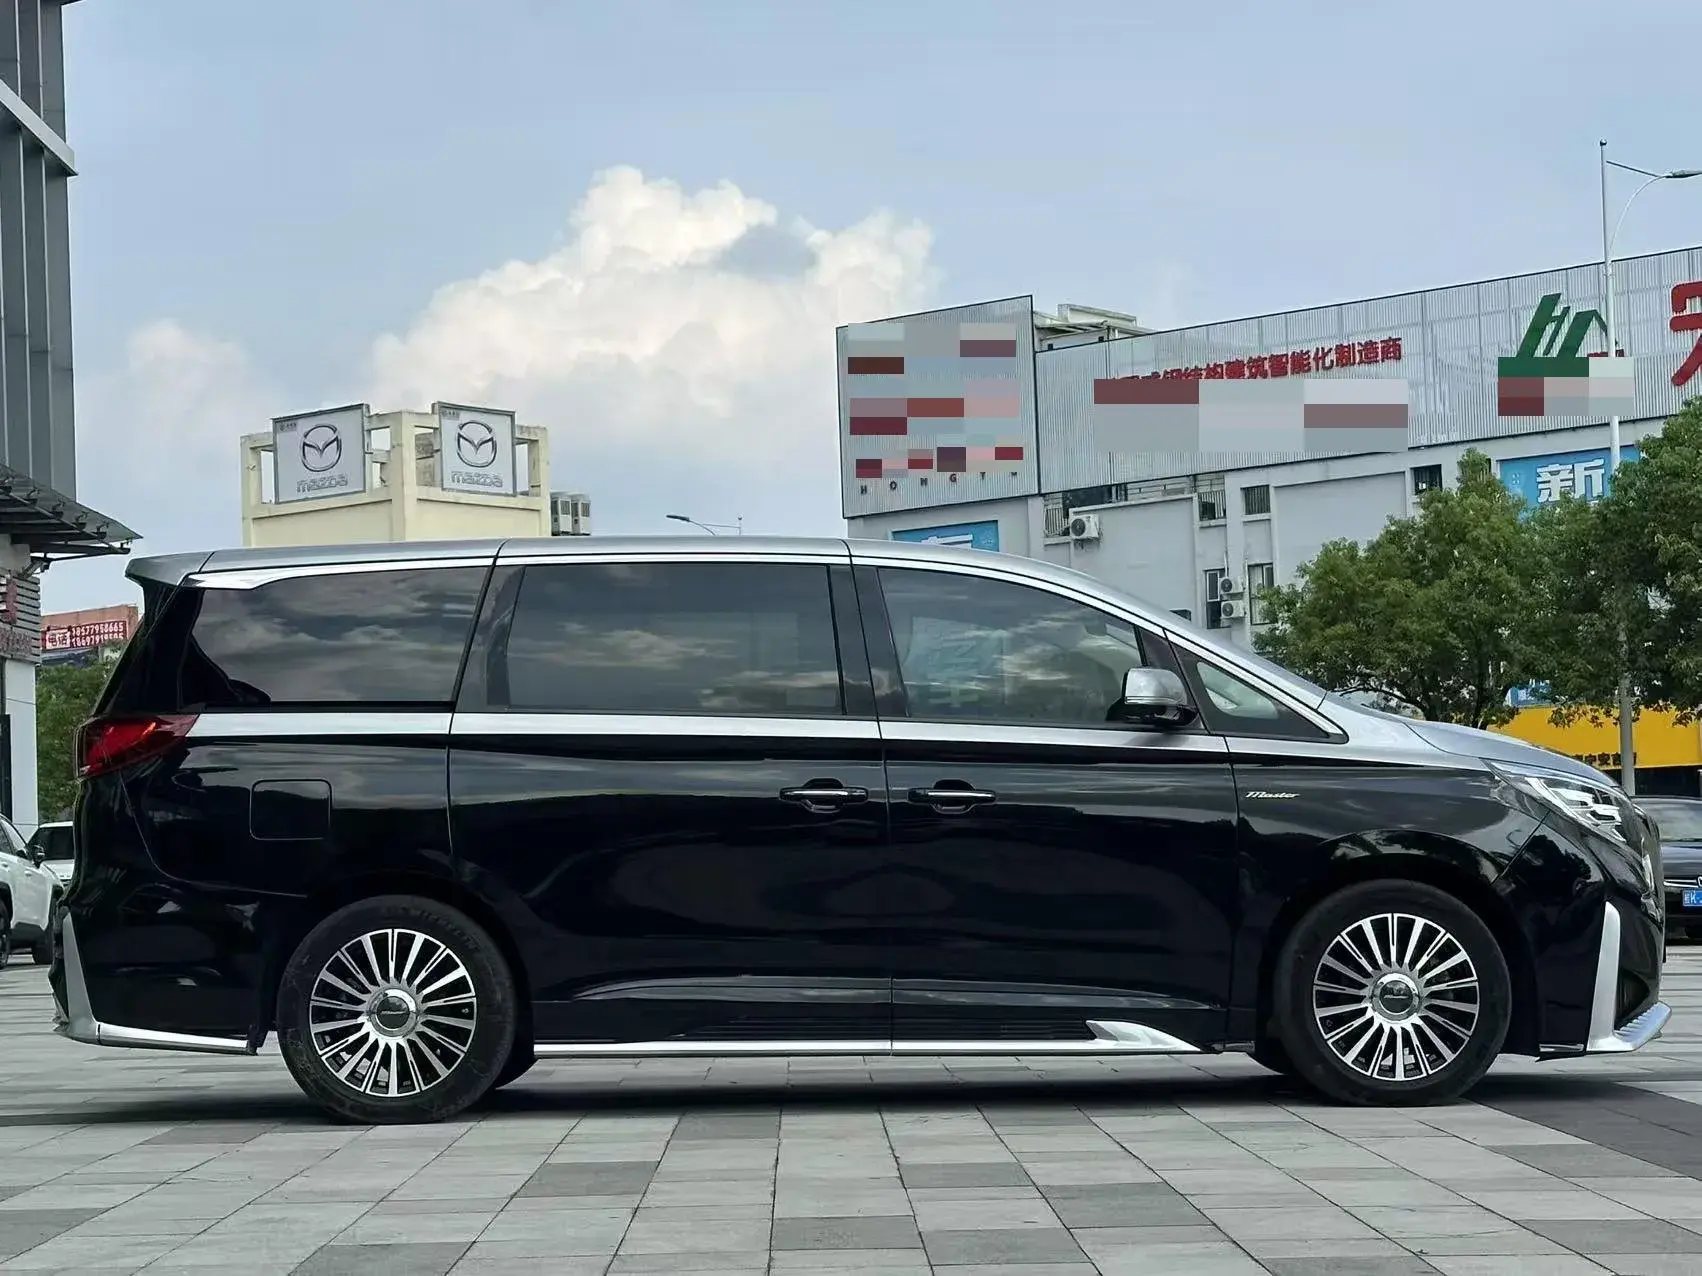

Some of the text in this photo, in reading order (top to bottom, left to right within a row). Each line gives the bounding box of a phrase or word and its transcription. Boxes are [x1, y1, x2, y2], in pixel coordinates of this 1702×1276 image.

[297, 473, 348, 492] mazda
[451, 470, 503, 488] mazda
[1536, 458, 1604, 504] 新
